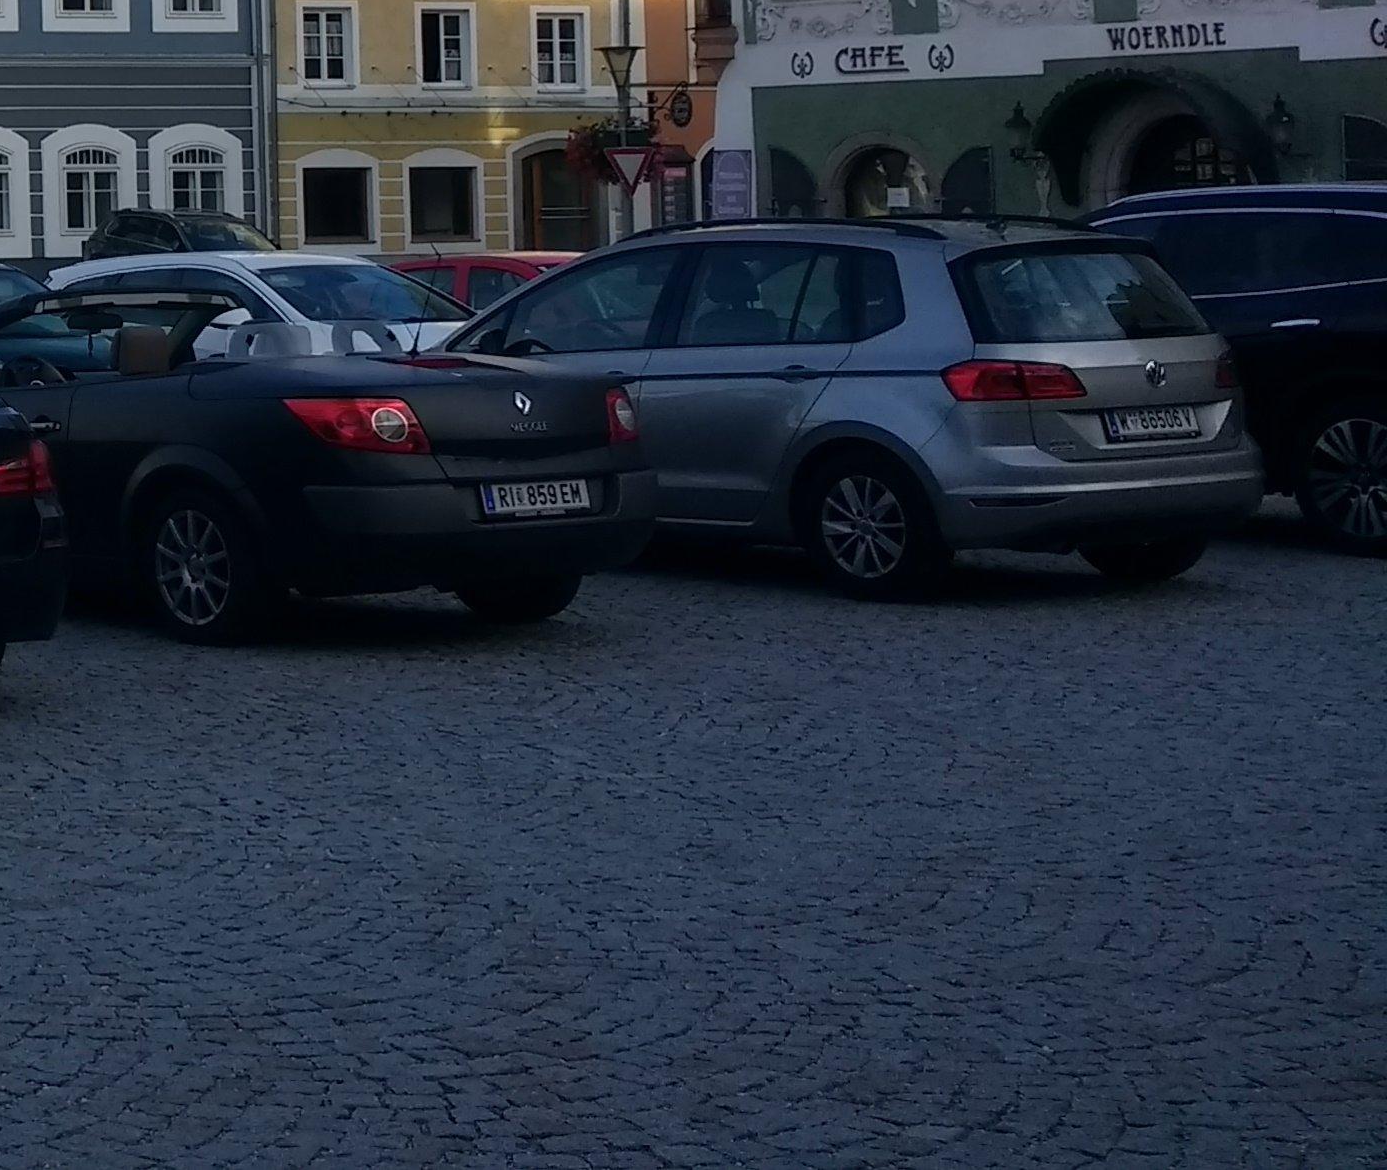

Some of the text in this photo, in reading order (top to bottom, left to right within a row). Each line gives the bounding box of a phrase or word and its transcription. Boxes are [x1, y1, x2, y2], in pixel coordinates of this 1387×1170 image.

[1106, 22, 1227, 51] WOERNDLE
[835, 45, 910, 75] CAFE
[1117, 411, 1130, 431] W
[1140, 408, 1183, 430] 86506
[497, 486, 516, 508] RI
[527, 484, 558, 506] 859
[559, 482, 583, 504] EM
